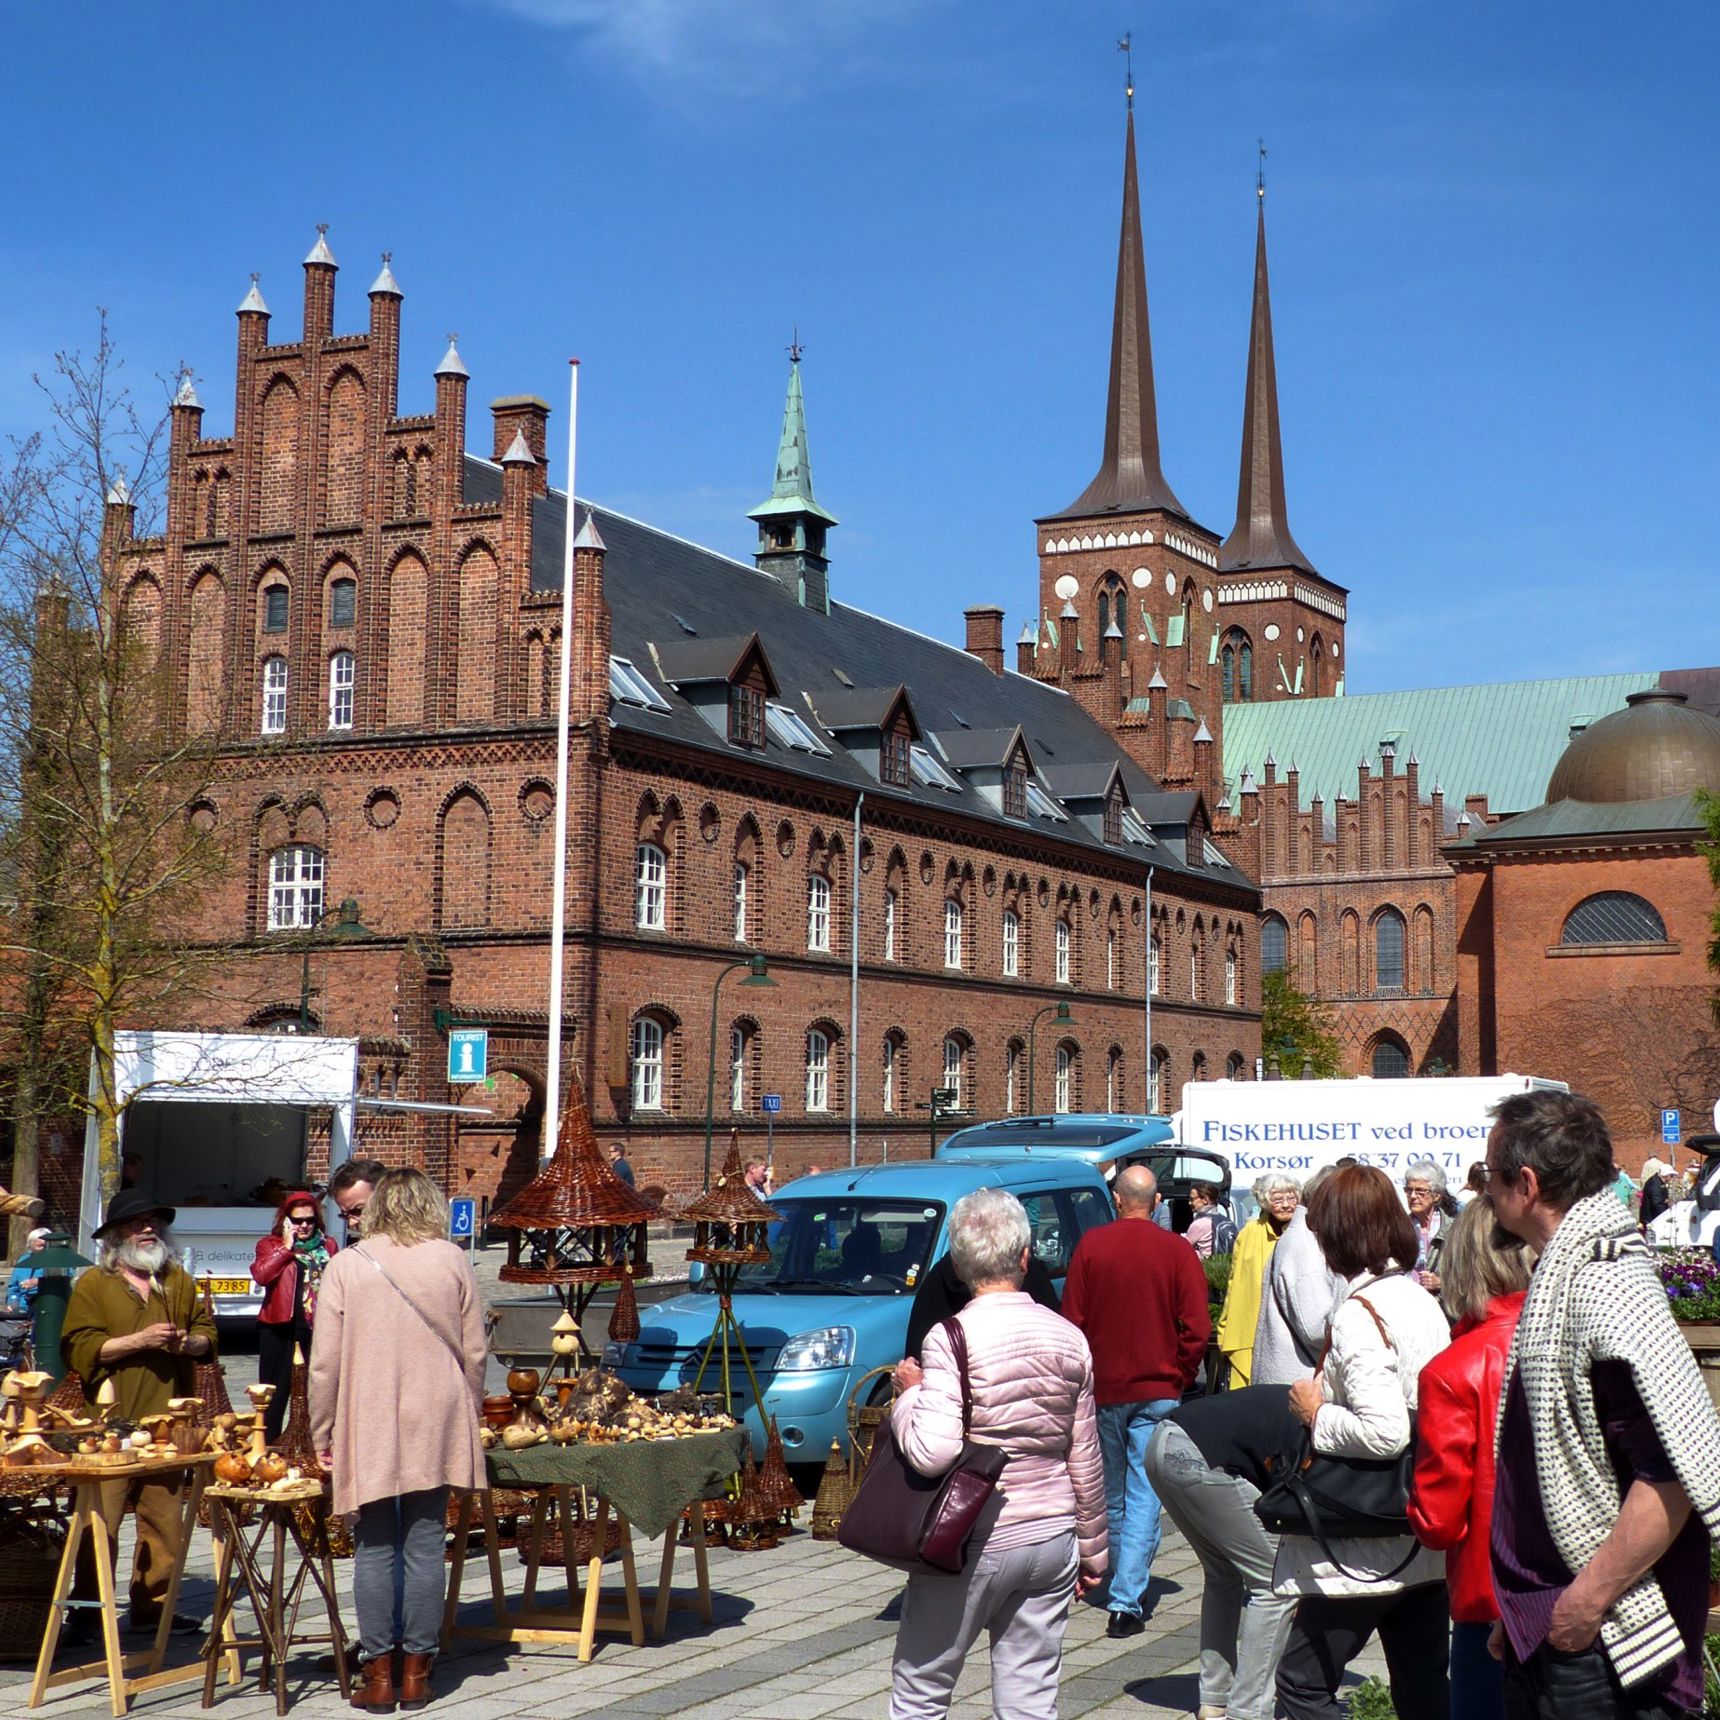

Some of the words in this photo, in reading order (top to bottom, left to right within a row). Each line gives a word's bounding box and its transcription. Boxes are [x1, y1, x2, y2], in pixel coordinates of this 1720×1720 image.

[452, 1033, 484, 1042] TOURIST
[764, 1098, 779, 1109] TAXI
[1665, 1112, 1676, 1125] P
[1370, 1122, 1413, 1140] ved
[1234, 1152, 1314, 1170] Korsør
[207, 1250, 256, 1261] delikate
